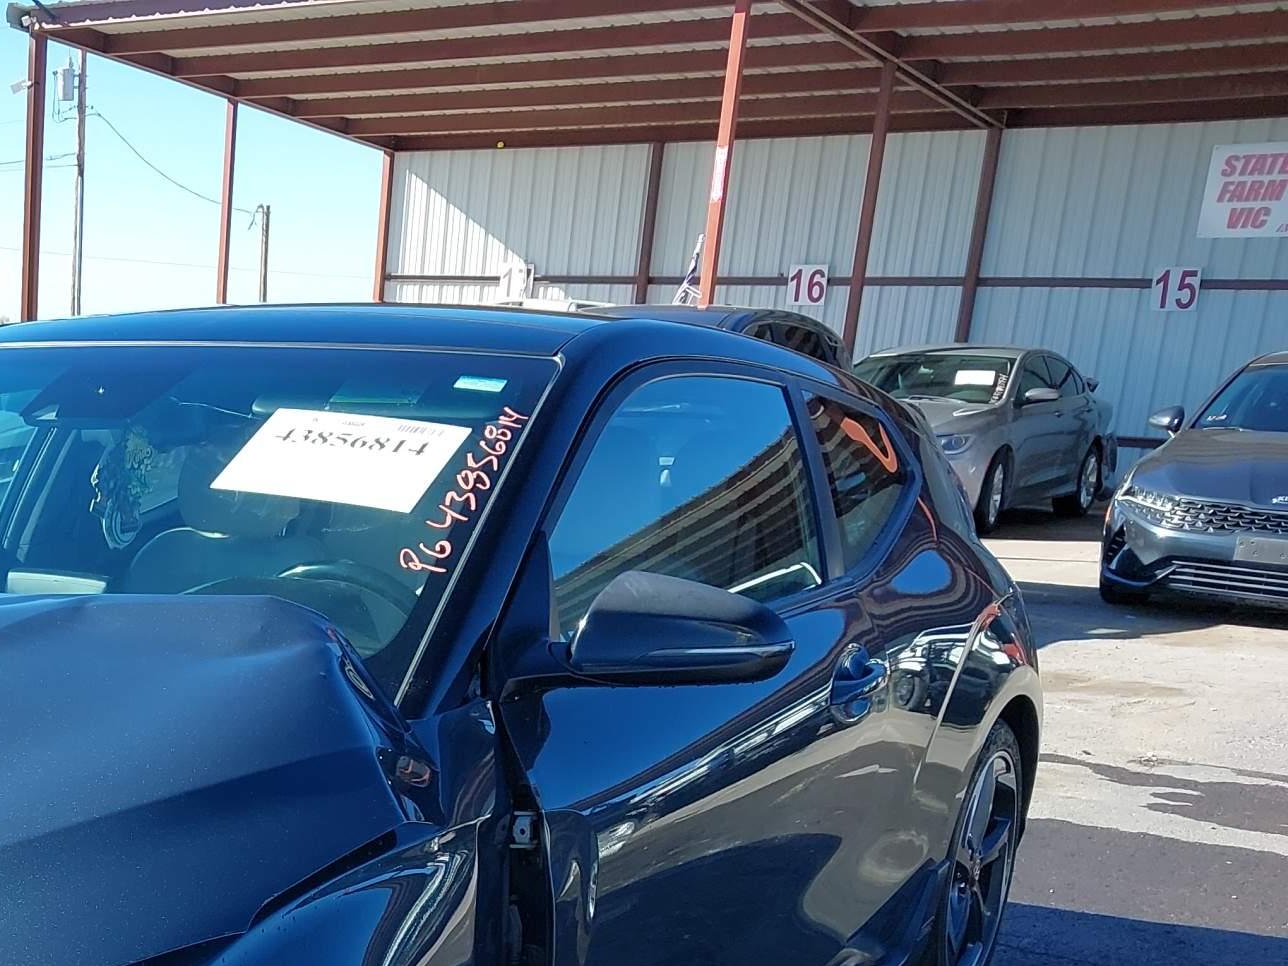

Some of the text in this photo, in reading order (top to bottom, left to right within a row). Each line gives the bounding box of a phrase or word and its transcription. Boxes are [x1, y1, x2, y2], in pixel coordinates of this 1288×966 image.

[1216, 179, 1288, 203] FARM
[1227, 206, 1272, 230] VIC
[790, 268, 825, 303] 16
[1155, 269, 1198, 309] 15
